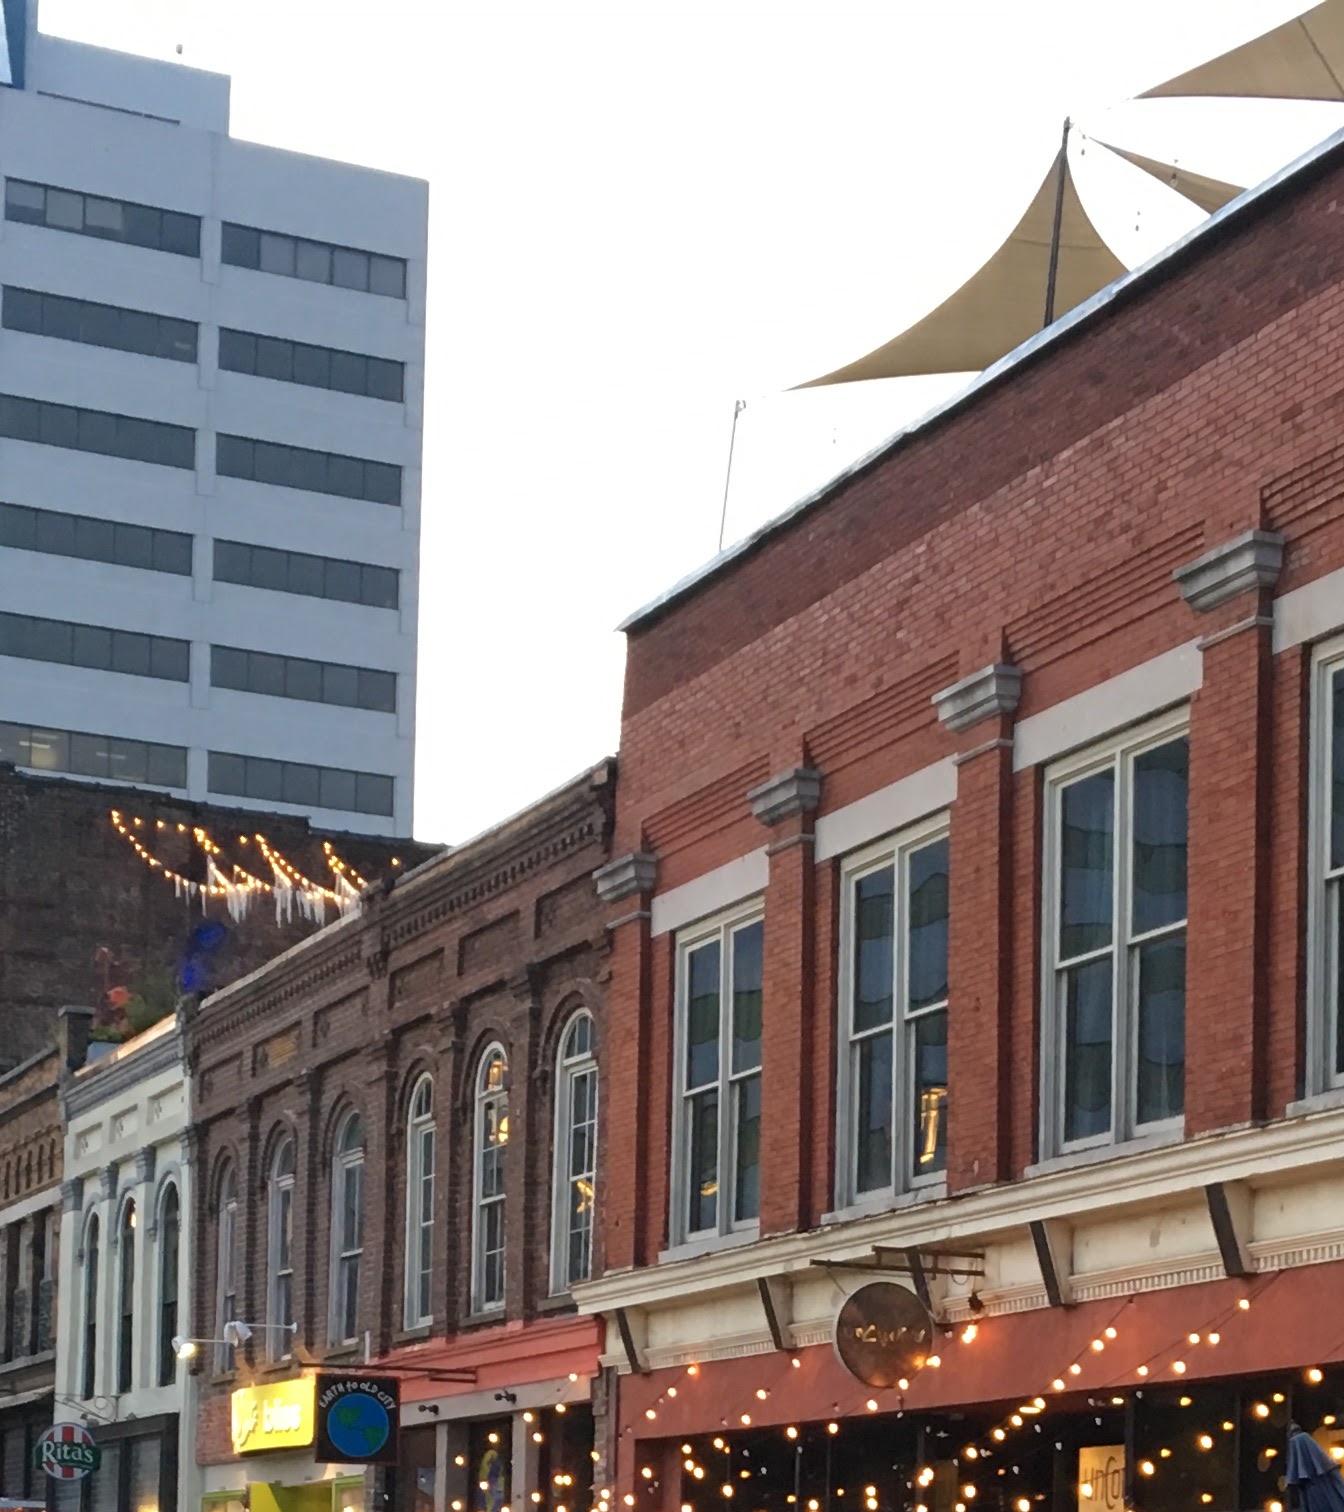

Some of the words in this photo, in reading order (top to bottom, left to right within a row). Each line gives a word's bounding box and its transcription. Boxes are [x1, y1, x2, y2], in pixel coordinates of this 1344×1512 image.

[319, 1382, 345, 1408] EARTH
[377, 1391, 396, 1409] CITY
[42, 1440, 94, 1463] Rita's
